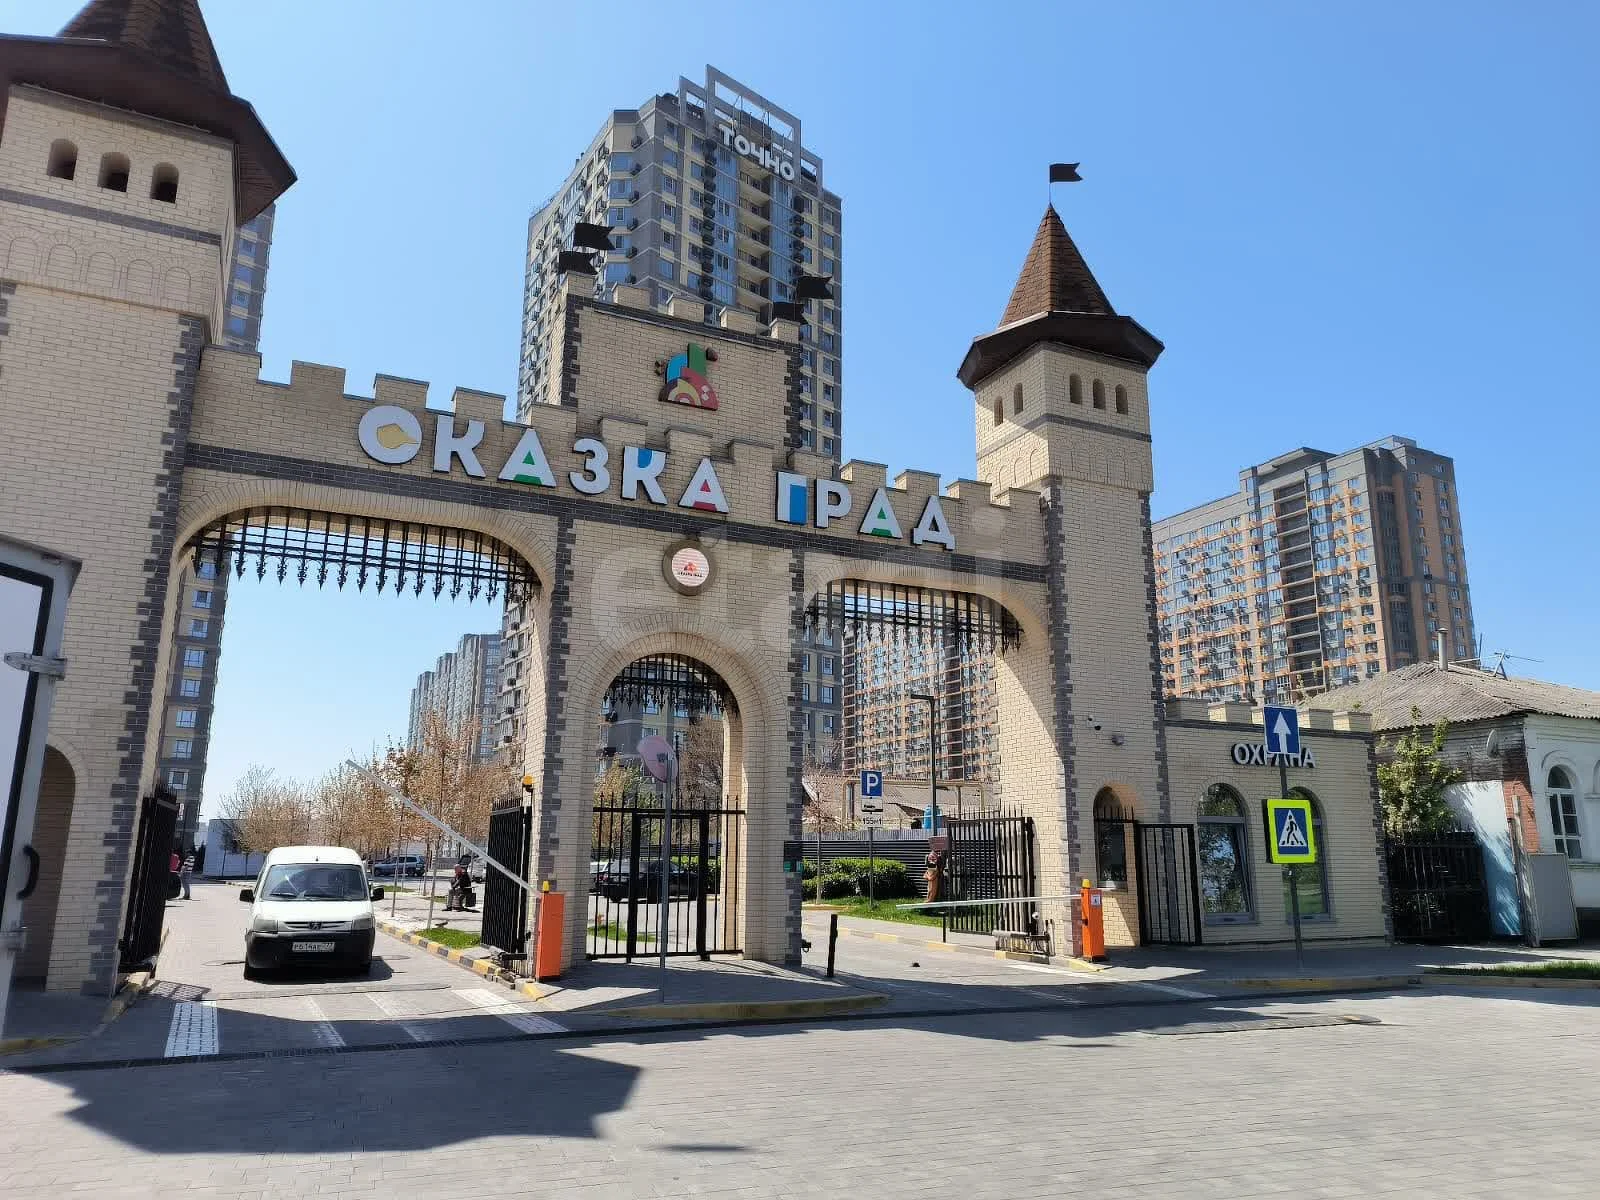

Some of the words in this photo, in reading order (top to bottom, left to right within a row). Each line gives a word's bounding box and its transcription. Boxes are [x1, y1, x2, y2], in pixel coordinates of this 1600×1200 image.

[719, 123, 795, 181] ТОЧНО
[776, 470, 956, 551] ГРАД
[866, 773, 879, 794] P
